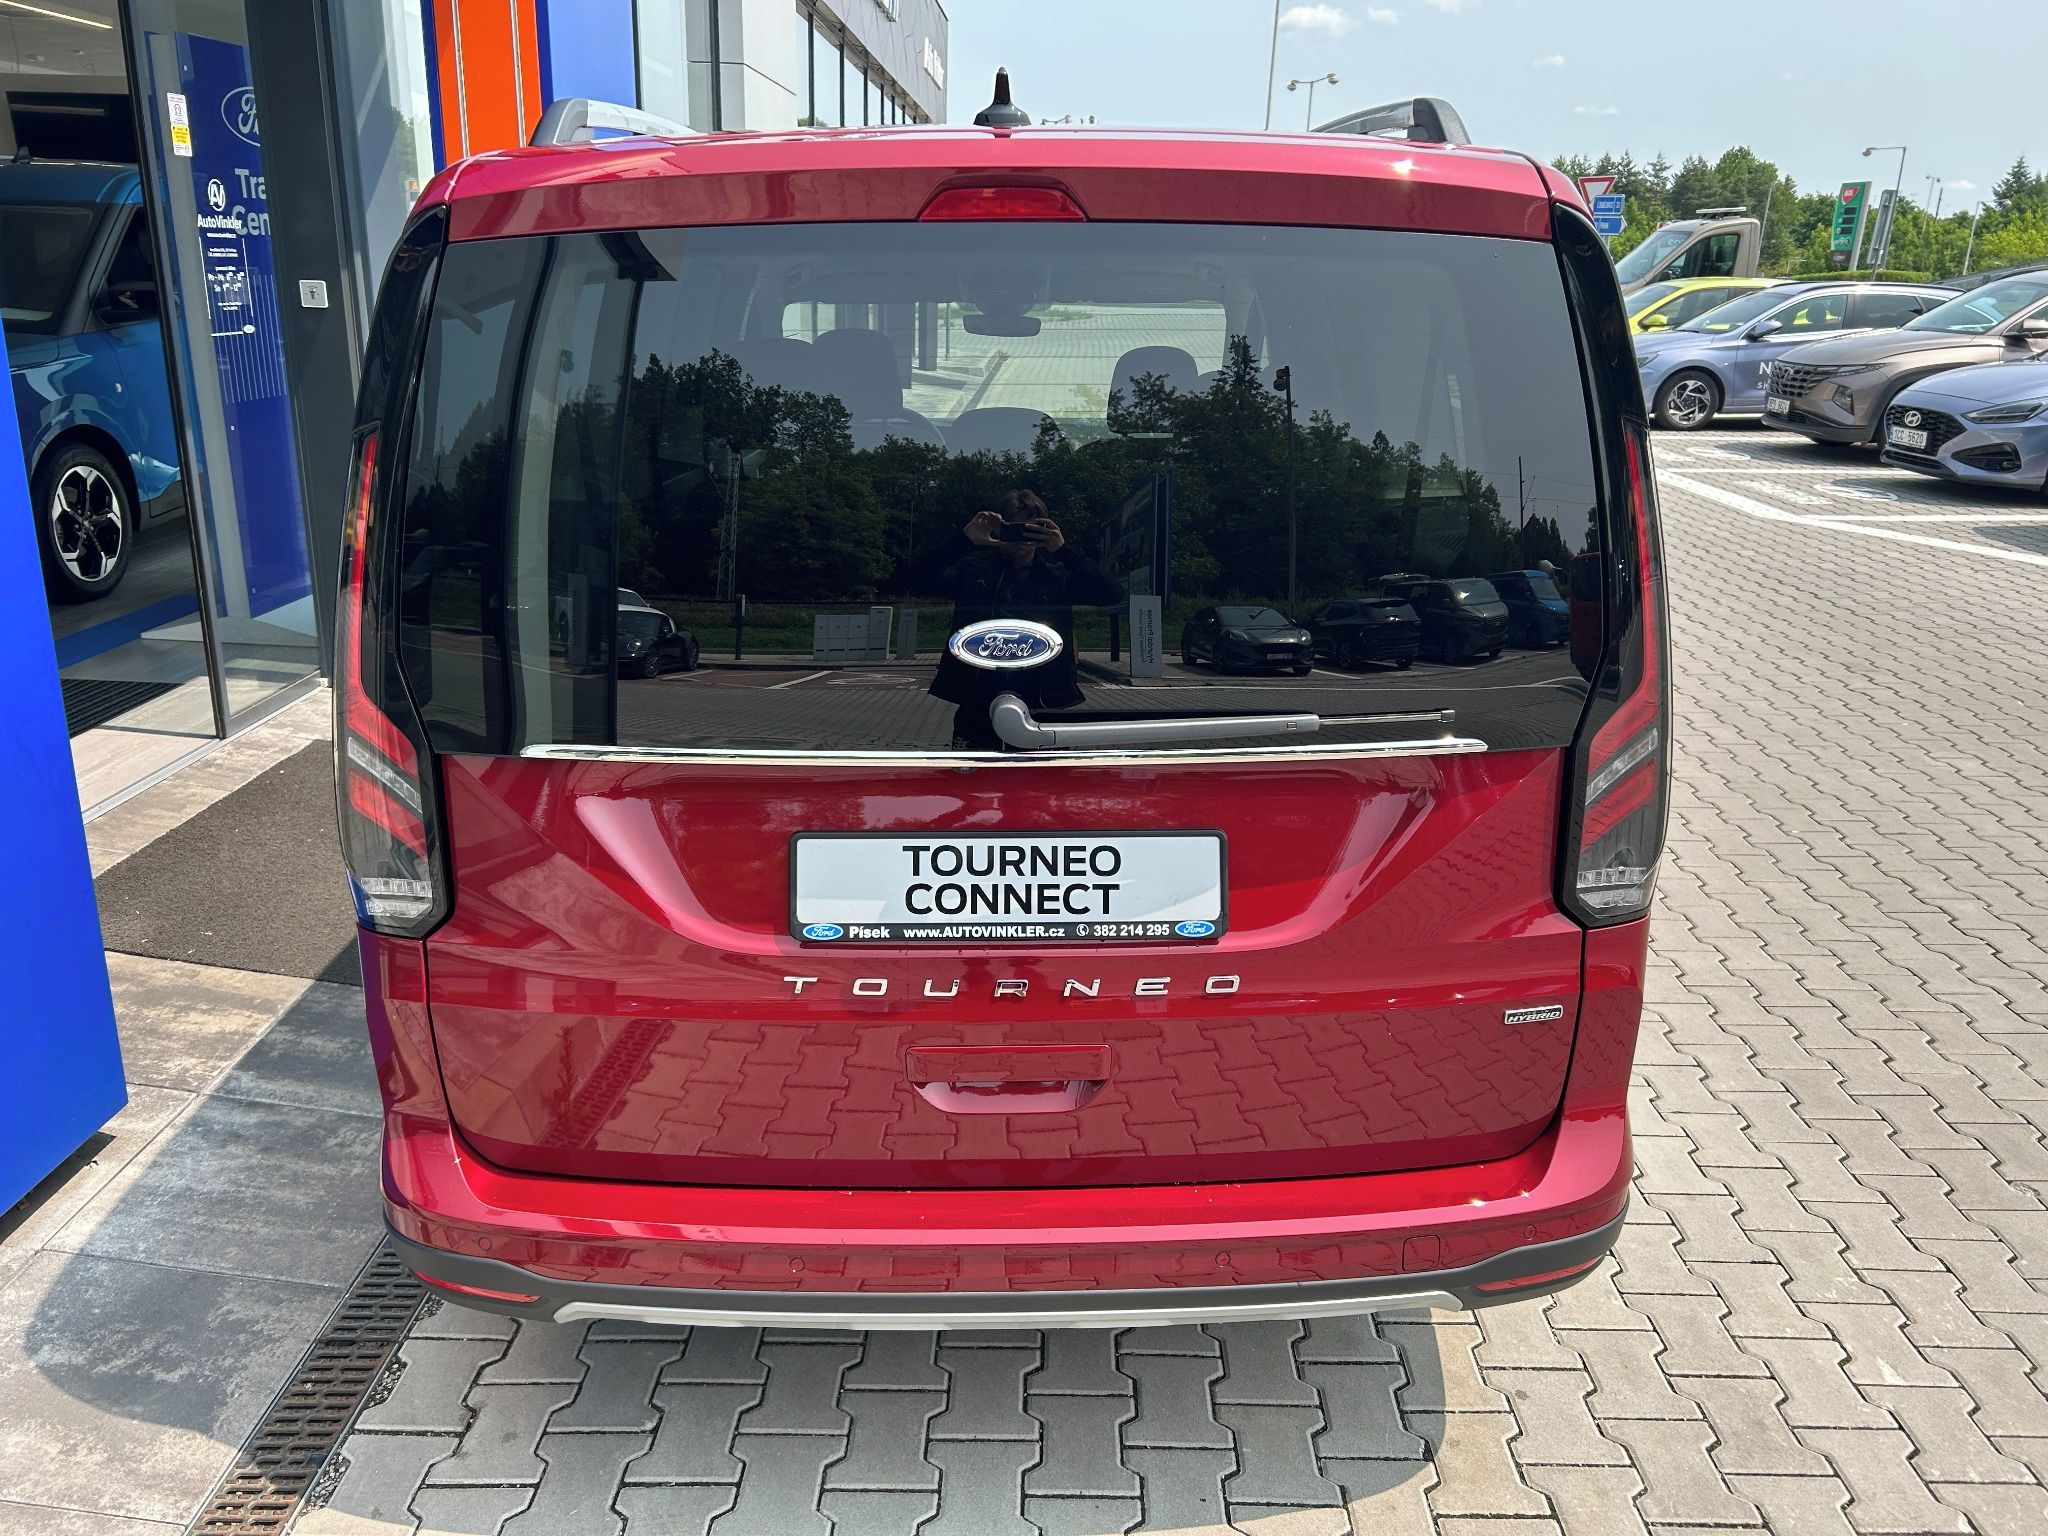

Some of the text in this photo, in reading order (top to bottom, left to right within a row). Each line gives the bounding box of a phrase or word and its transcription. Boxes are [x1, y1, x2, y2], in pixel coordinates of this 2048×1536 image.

[197, 213, 242, 229] AutoVinkler
[978, 633, 1034, 657] Ford
[902, 844, 1122, 877] TOURNEO
[904, 883, 1121, 915] CONNECT
[849, 923, 1170, 939] Písek www.AUTOVINKLER.cz 382 214 295
[783, 974, 1240, 997] TOURNEO
[1507, 1011, 1560, 1023] HYBRID
